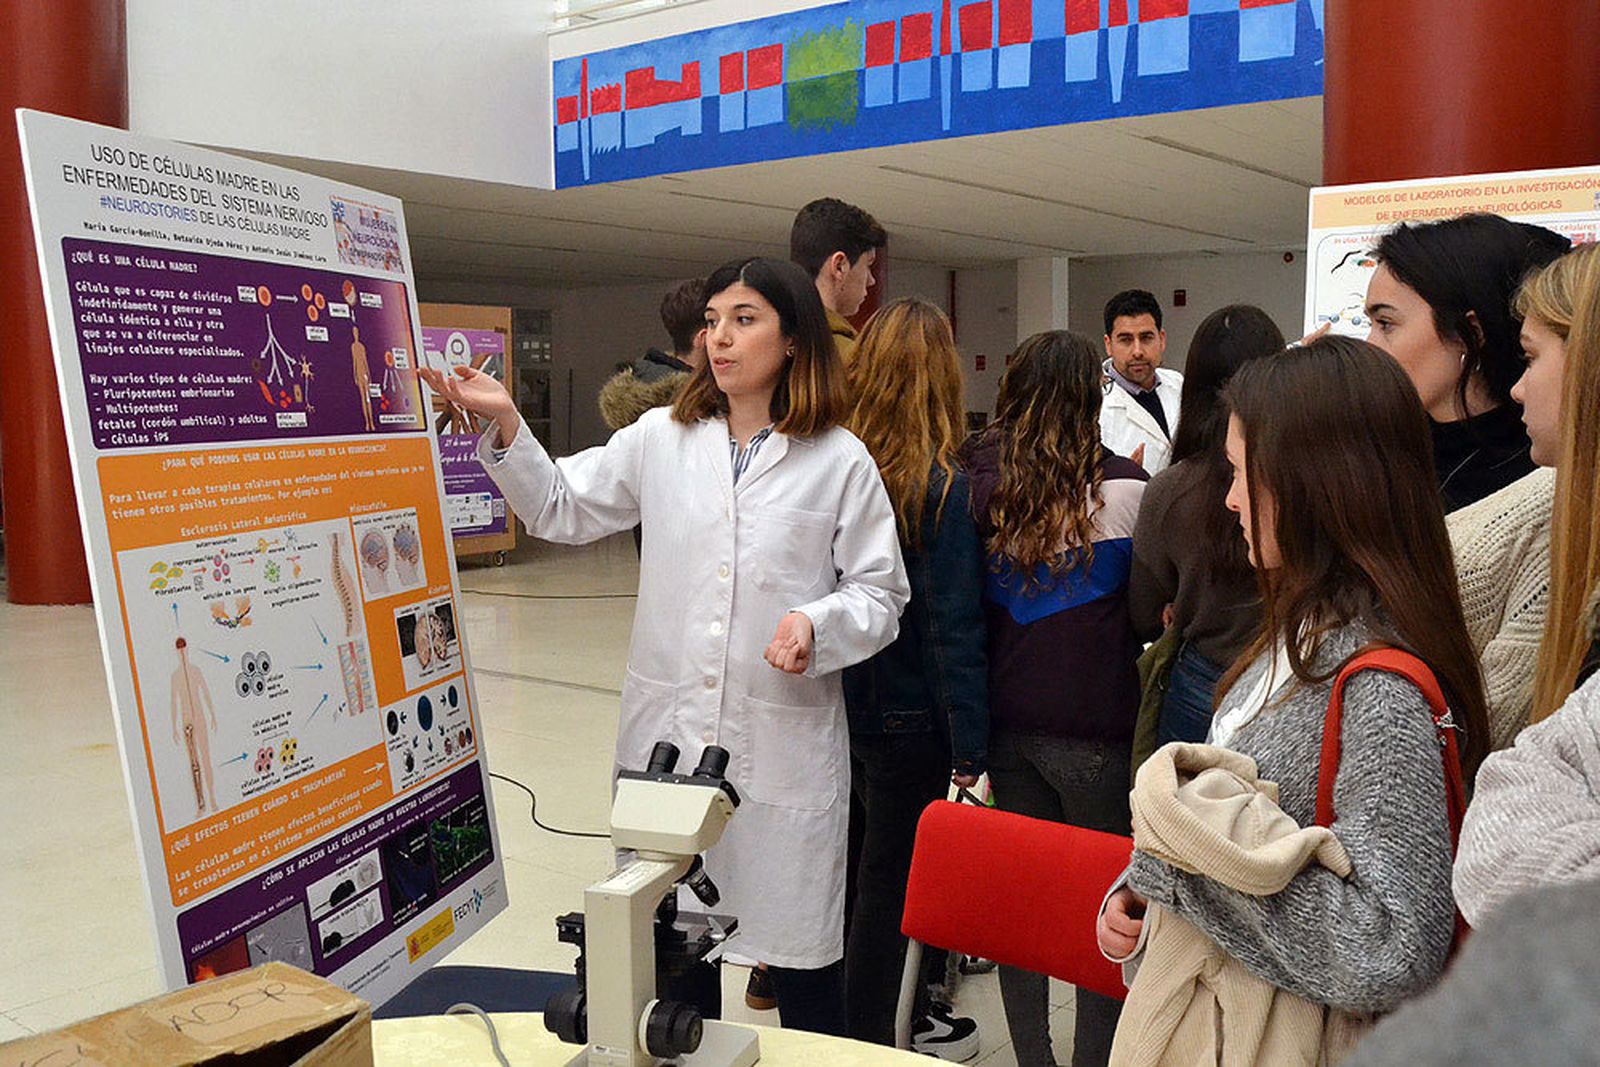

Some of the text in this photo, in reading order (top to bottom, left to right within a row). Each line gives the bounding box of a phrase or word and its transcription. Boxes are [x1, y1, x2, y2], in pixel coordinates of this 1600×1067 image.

[90, 144, 300, 201] USO DE CÉLULAS MADRE EN LAS
[62, 164, 328, 228] ENFERMEDADES DEL SISTEMA NERVIOSO
[1344, 194, 1391, 206] MODELOS
[1394, 192, 1408, 202] DE
[1410, 187, 1482, 201] LABORATORIO
[1484, 186, 1498, 196] EN
[1502, 185, 1514, 194] LA
[100, 195, 310, 241] #NEUROSTORIES DE LAS CÉLULAS MADRE
[1376, 211, 1389, 221] DE
[72, 250, 198, 274] ¿QUÉ ES UNA CÉLULA MADRE?
[75, 281, 110, 294] Célula
[114, 286, 130, 297] que
[135, 288, 146, 296] es
[150, 288, 174, 302] capaz
[178, 288, 189, 300] de
[192, 290, 233, 304] dividirse
[78, 296, 222, 316] indefinidamente y generar una
[80, 313, 224, 330] célula idéntica a ella y otra
[82, 329, 214, 342] que se va a diferenciar en
[85, 342, 124, 356] linajes
[178, 346, 244, 358] especializados.
[89, 372, 253, 386] Hay varios tipos de células madre:
[104, 389, 176, 402] Pluripotentes:
[106, 404, 178, 416] Multipotentes:
[98, 418, 137, 430] fetales
[142, 416, 177, 429] (cordón
[180, 416, 226, 426] umbilical)
[230, 417, 234, 426] y
[112, 432, 170, 445] Células iPS
[109, 494, 132, 504] Para
[136, 490, 168, 501] llevar
[172, 489, 178, 498] a
[182, 487, 201, 496] cabo
[205, 480, 242, 495] terapias
[112, 508, 146, 520] tienen
[150, 503, 176, 515] otros
[180, 499, 217, 512] posibles
[221, 494, 274, 506] tratamientos.
[180, 524, 228, 537] Esclerosis
[232, 518, 262, 531] Lateral
[194, 819, 230, 842] EFECTOS
[232, 808, 260, 827] TIENEN
[290, 790, 300, 800] SE
[175, 868, 191, 883] Las
[196, 850, 230, 873] células
[233, 838, 256, 857] madre
[259, 825, 286, 844] tienen
[262, 868, 284, 890] ¿CÓMO
[286, 863, 295, 876] SE
[298, 848, 326, 869] APLICAR
[328, 841, 340, 854] LAS
[342, 827, 366, 846] CÉLULAS
[178, 886, 189, 898] se
[249, 854, 258, 864] en
[262, 846, 270, 858] el
